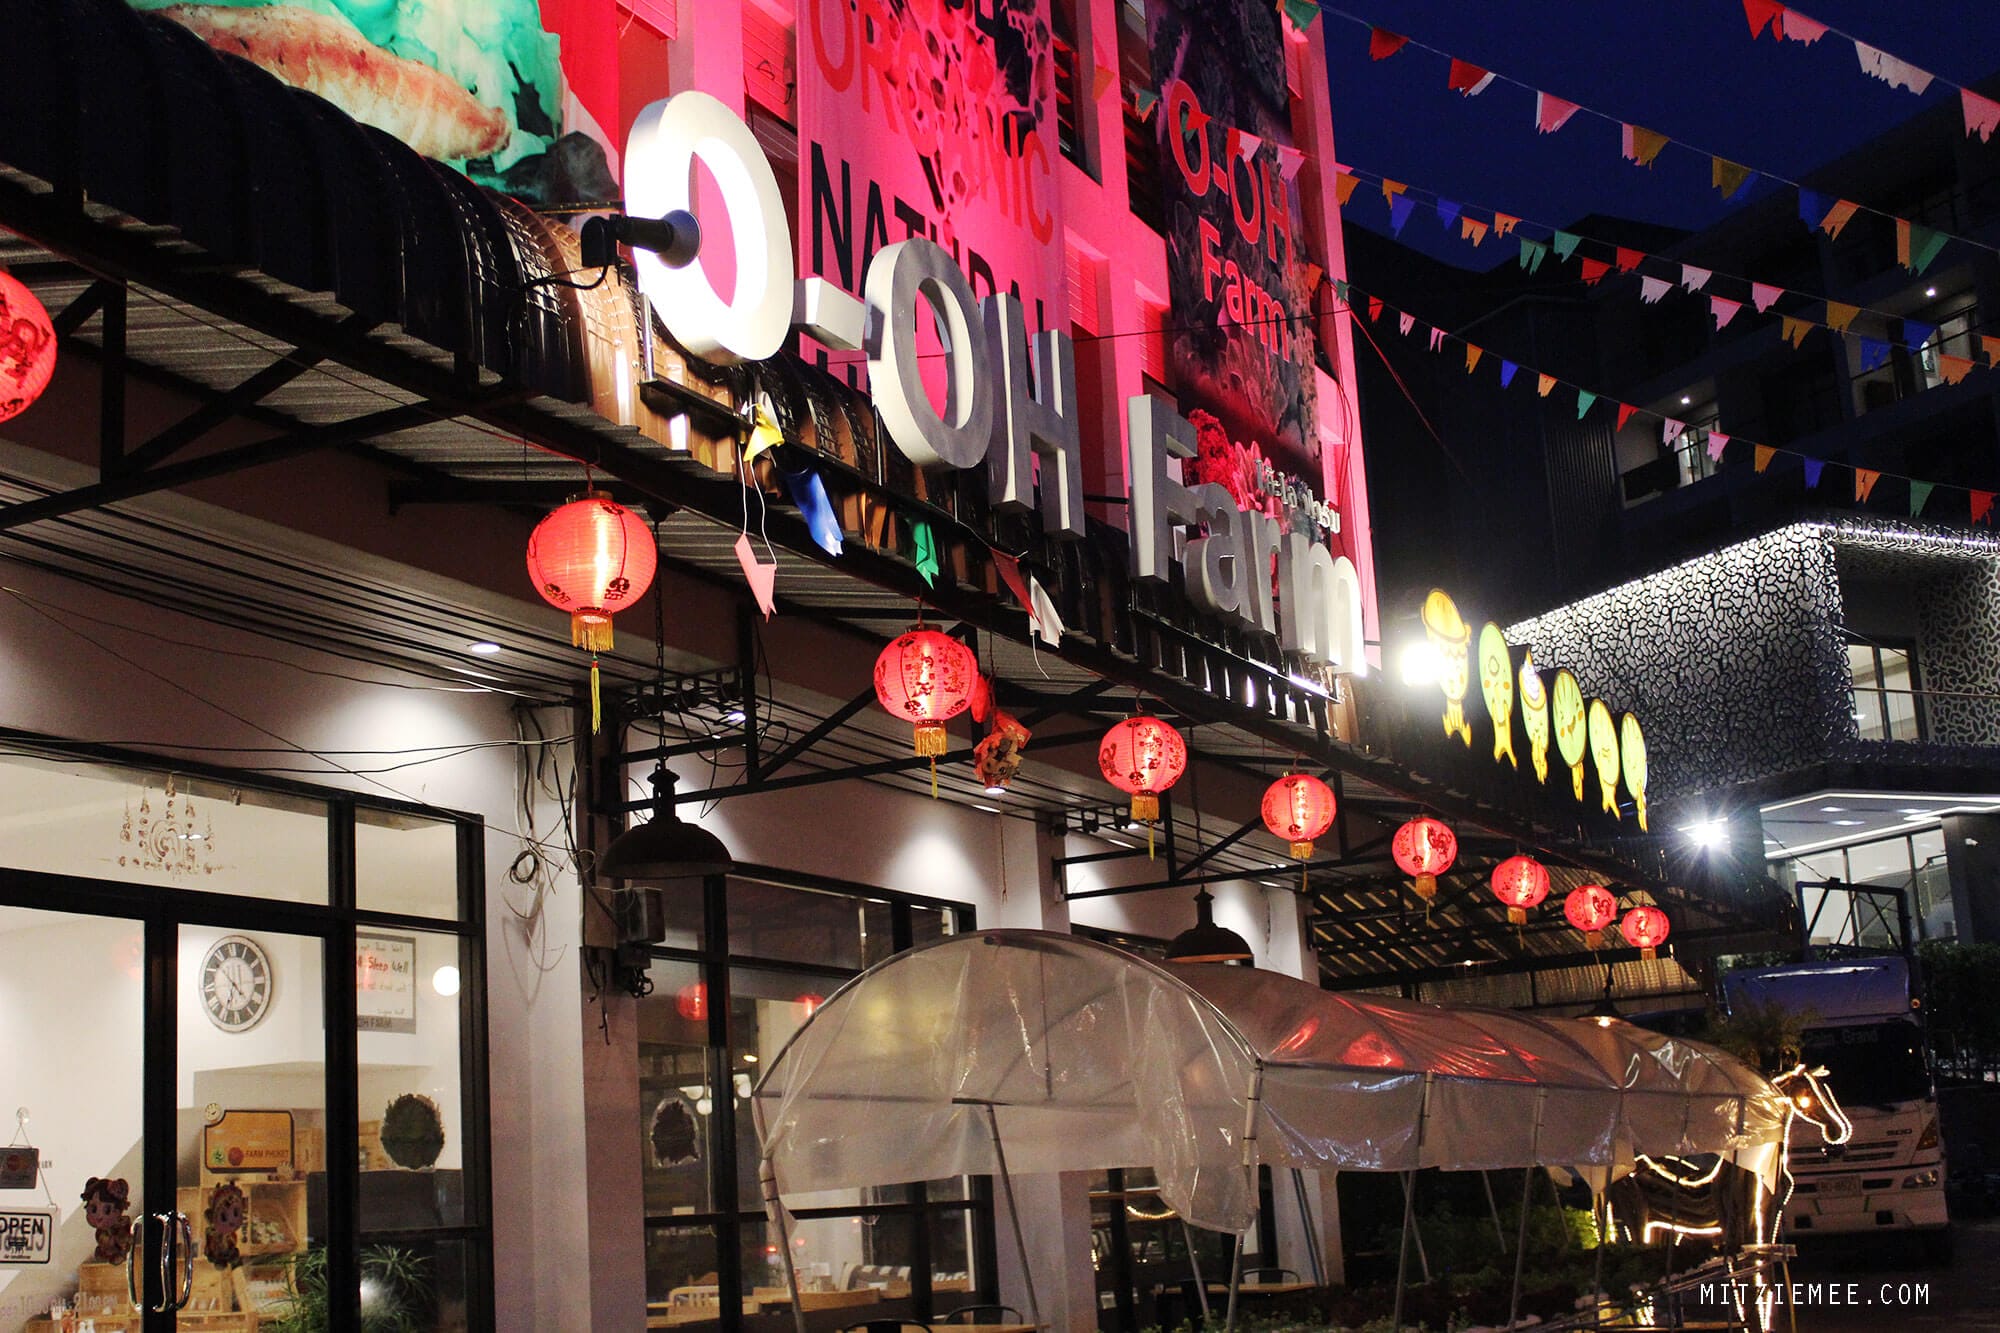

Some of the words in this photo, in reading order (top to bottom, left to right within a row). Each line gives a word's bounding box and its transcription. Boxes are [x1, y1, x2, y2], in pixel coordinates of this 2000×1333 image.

[810, 0, 1053, 246] ORGANIC
[1168, 79, 1294, 278] O-OH
[624, 90, 1085, 538] O-OH
[1199, 215, 1289, 363] Farm
[1128, 394, 1366, 677] Farm
[0, 1217, 44, 1235] OPEN
